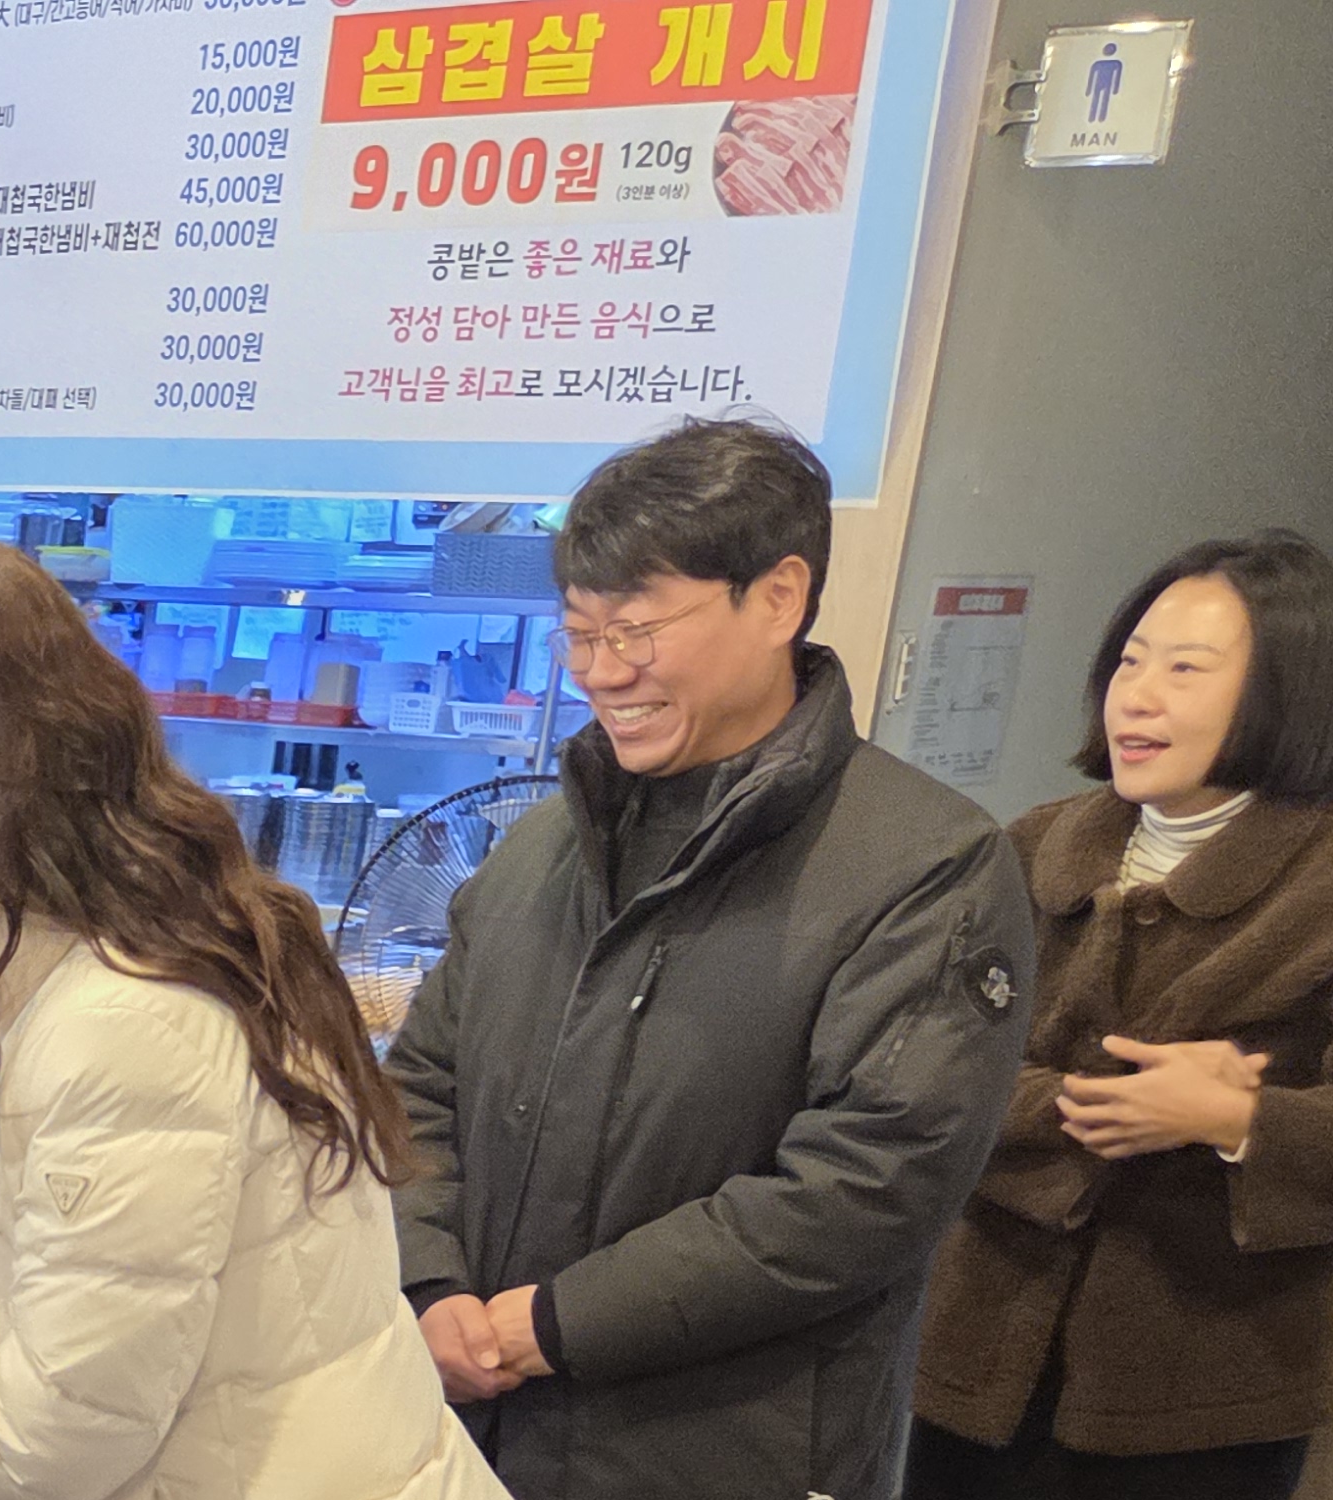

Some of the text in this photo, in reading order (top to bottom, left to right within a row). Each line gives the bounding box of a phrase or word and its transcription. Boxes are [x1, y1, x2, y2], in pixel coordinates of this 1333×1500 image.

[199, 36, 301, 74] 15,000원
[359, 0, 826, 107] 삼겹살 개시
[191, 81, 295, 117] 20,000원
[185, 128, 290, 160] 30,000원
[1070, 131, 1118, 148] MAN
[179, 173, 284, 207] 45,000원
[349, 138, 694, 213] 9,000원 120g
[615, 183, 691, 203] (3인분 이상)
[174, 217, 278, 250] 60,000원
[427, 236, 691, 281] 콩밭은 좋은 재료와
[166, 283, 270, 316] 30,000원
[387, 301, 717, 343] 정성 담아 만든 음식으로
[160, 332, 264, 364] 30,000원
[62, 386, 97, 411] 선택)
[154, 380, 257, 411] 30,000원
[337, 364, 754, 404] 고객님을 최고로 모시겠습니다.
